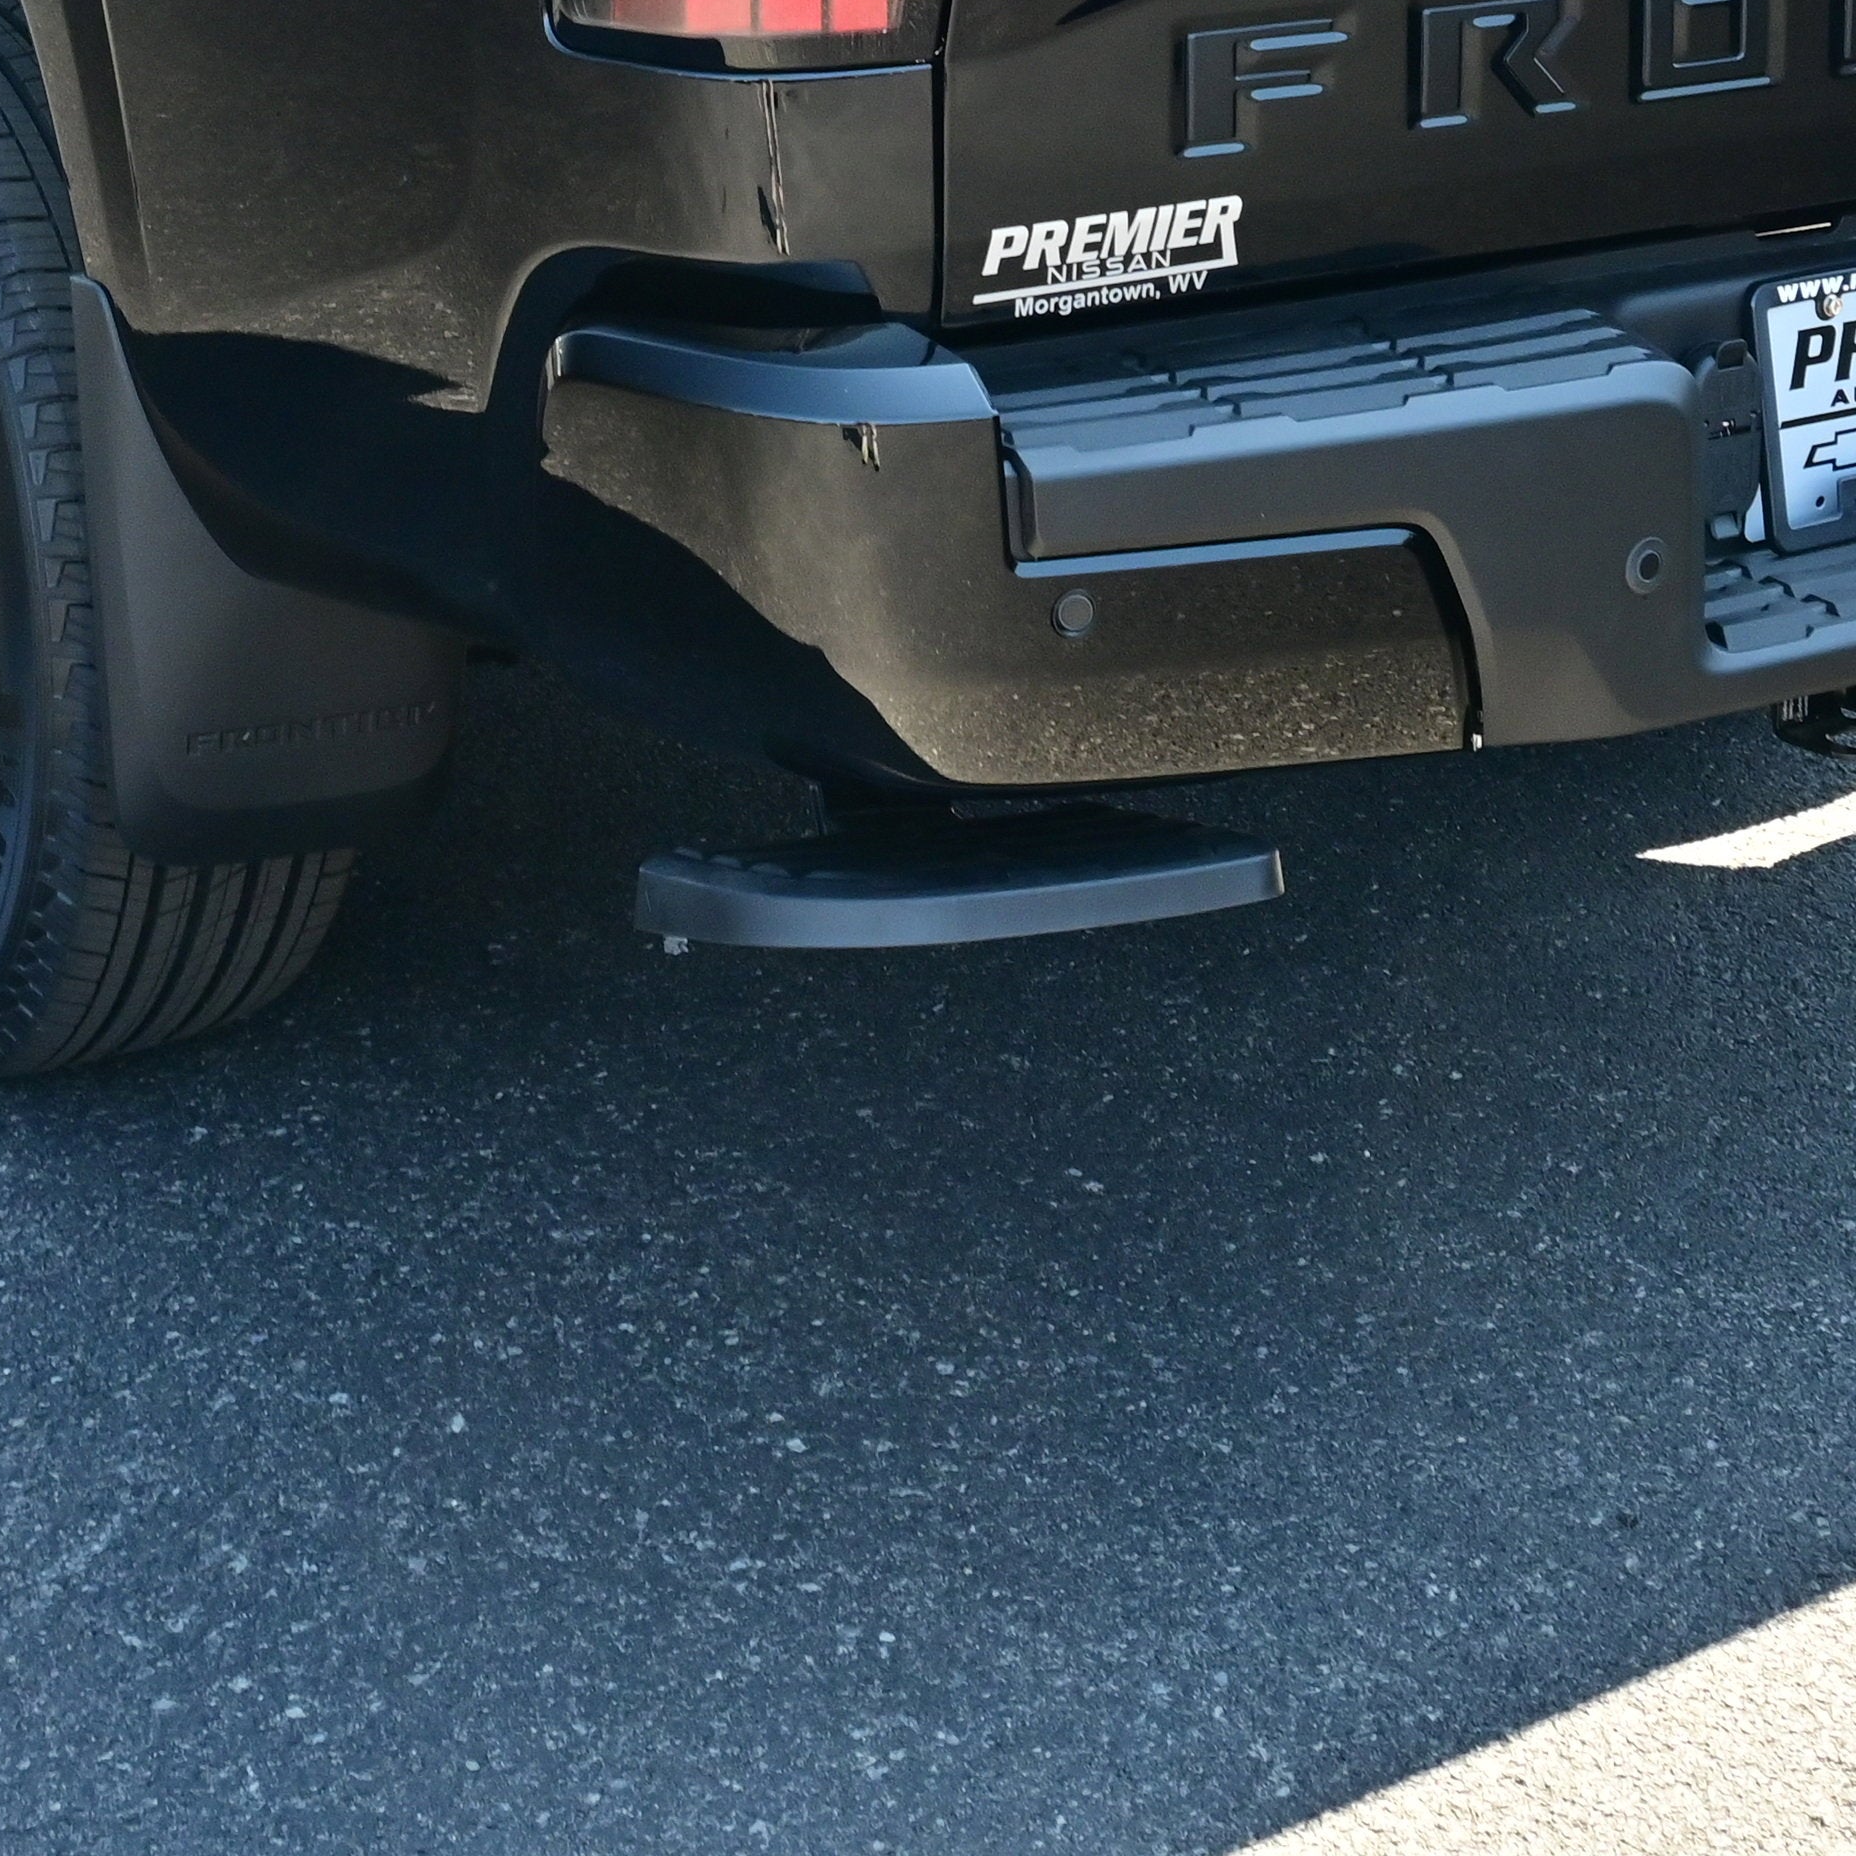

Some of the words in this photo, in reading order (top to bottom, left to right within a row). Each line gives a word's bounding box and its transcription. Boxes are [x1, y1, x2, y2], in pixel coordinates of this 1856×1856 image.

[981, 194, 1244, 276] PREMIER
[1046, 249, 1172, 285] NISSAN
[1013, 280, 1162, 318] Morgantown,
[1169, 270, 1209, 295] WV
